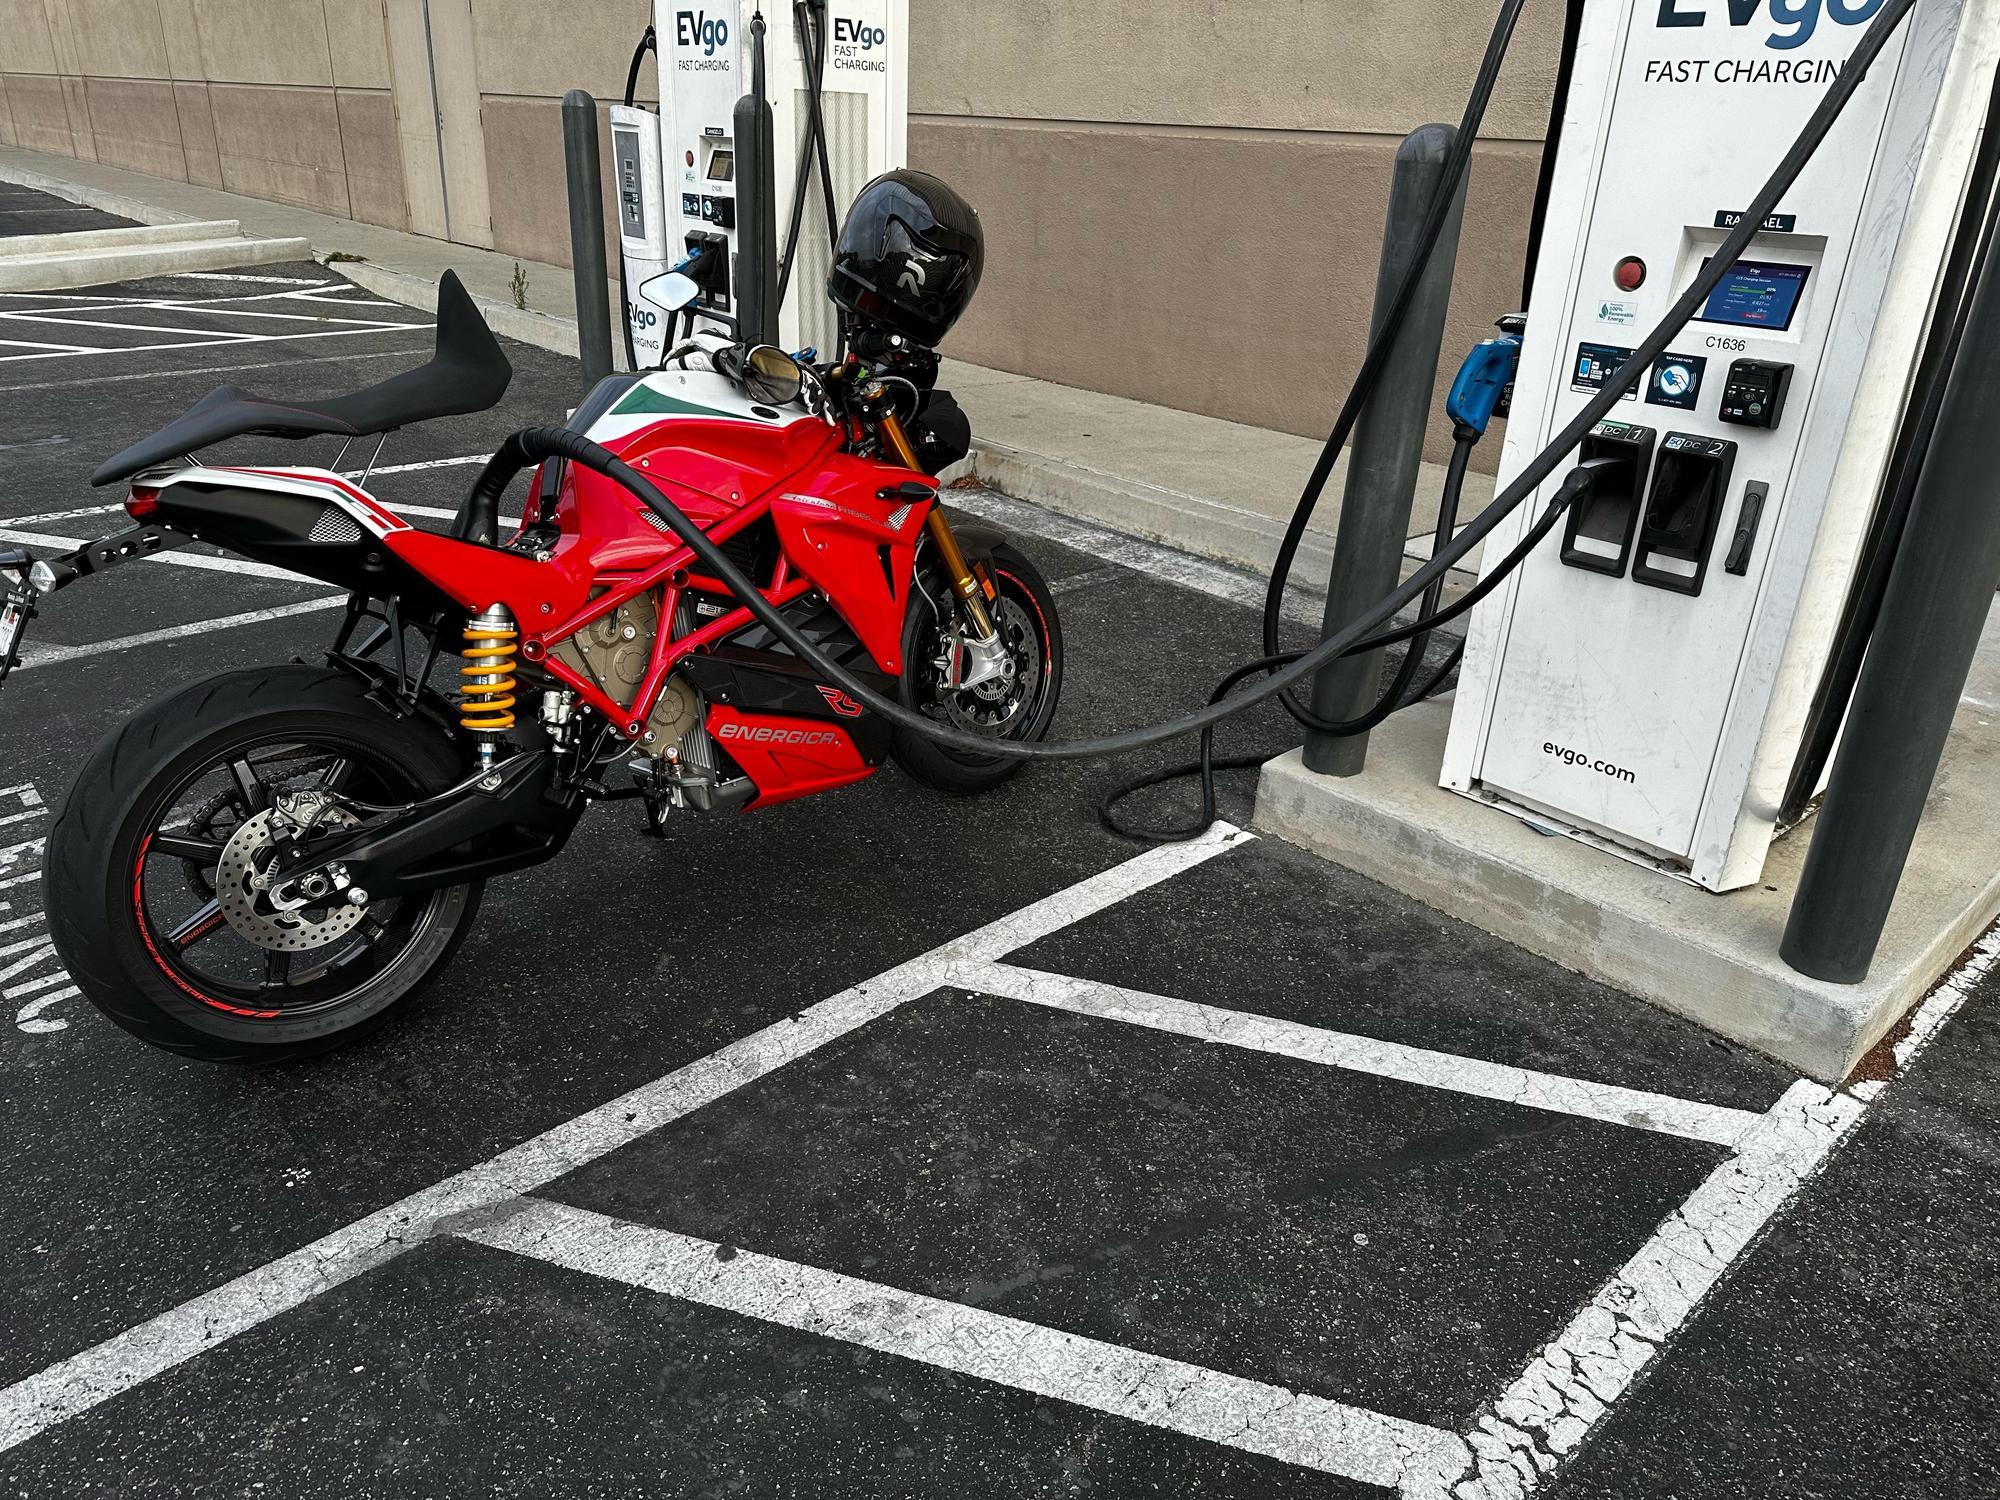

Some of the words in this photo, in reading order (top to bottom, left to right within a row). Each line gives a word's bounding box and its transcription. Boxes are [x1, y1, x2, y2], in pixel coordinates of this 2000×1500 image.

[677, 10, 728, 56] EVgo
[834, 17, 885, 50] EVgo
[834, 45, 858, 57] FAST
[678, 59, 693, 71] FAST
[694, 59, 730, 71] CHARGING
[834, 58, 885, 72] CHARGING
[1645, 60, 1709, 83] FAST
[1714, 59, 1867, 84] CHARGIN
[1724, 214, 1784, 229] RAAEL
[1705, 335, 1746, 351] C1636
[1604, 426, 1622, 435] DC
[1632, 429, 1643, 440] 1
[1683, 440, 1701, 449] DC
[1707, 442, 1724, 455] 2
[1542, 742, 1636, 784] evgo.com
